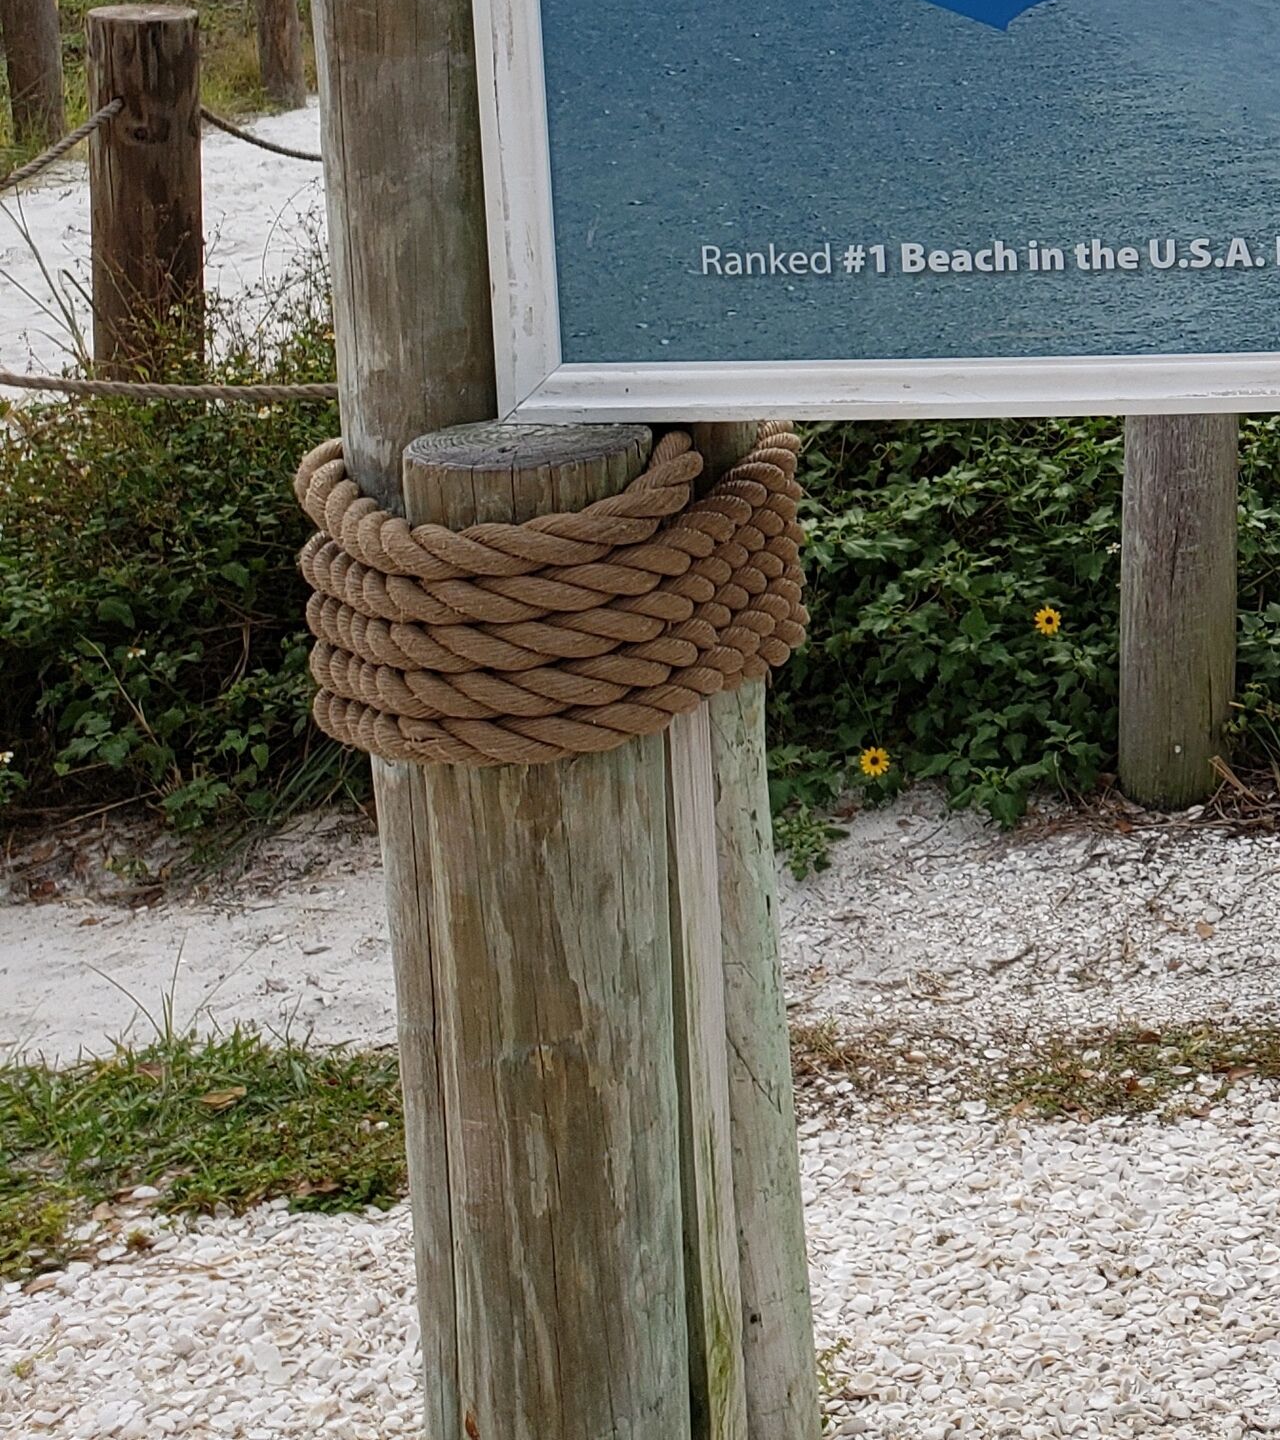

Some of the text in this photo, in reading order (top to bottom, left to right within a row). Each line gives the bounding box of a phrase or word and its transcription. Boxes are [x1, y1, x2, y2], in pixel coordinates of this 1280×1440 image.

[700, 244, 831, 275] Ranked
[843, 243, 886, 273] #1
[901, 240, 1019, 272] Beach
[1028, 240, 1068, 272] in
[1074, 239, 1140, 271] the
[1147, 237, 1265, 270] U.S.A.
